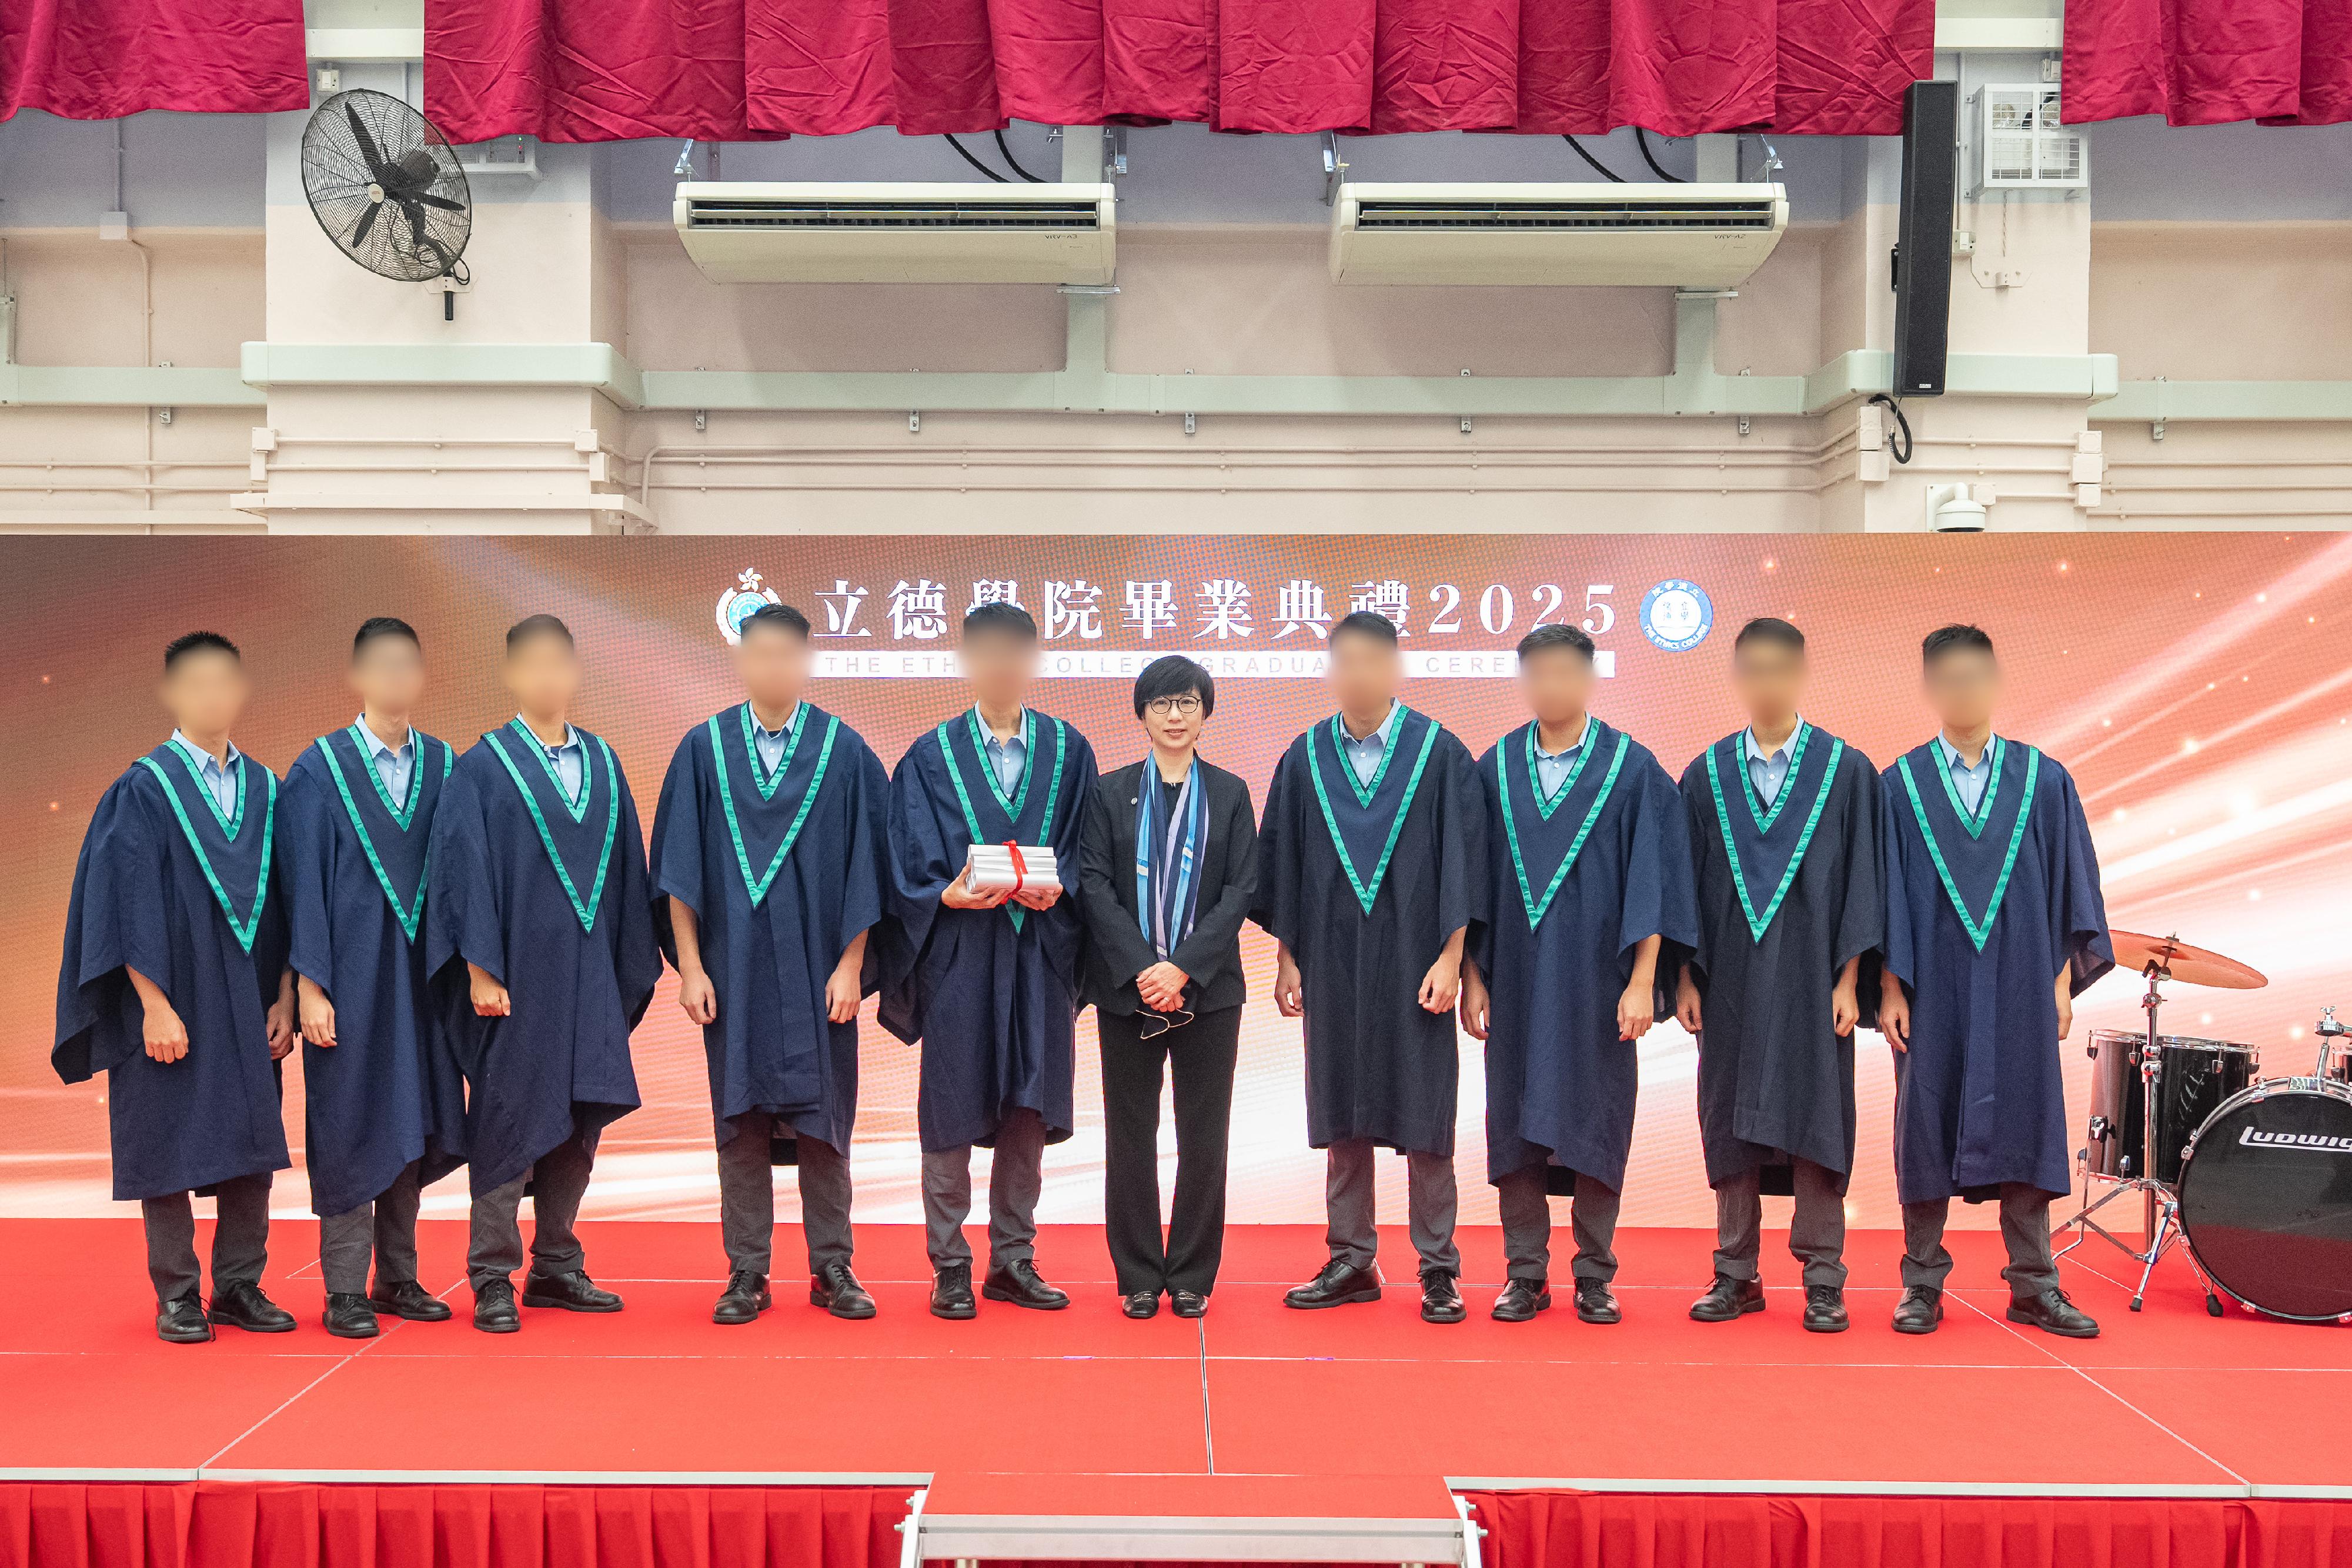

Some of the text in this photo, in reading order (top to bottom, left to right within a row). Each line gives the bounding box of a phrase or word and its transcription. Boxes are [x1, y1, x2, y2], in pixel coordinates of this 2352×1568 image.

[825, 657, 880, 673] THE
[903, 657, 956, 673] ETH
[1039, 657, 1154, 673] OLLE
[1199, 657, 1325, 673] GRADUA
